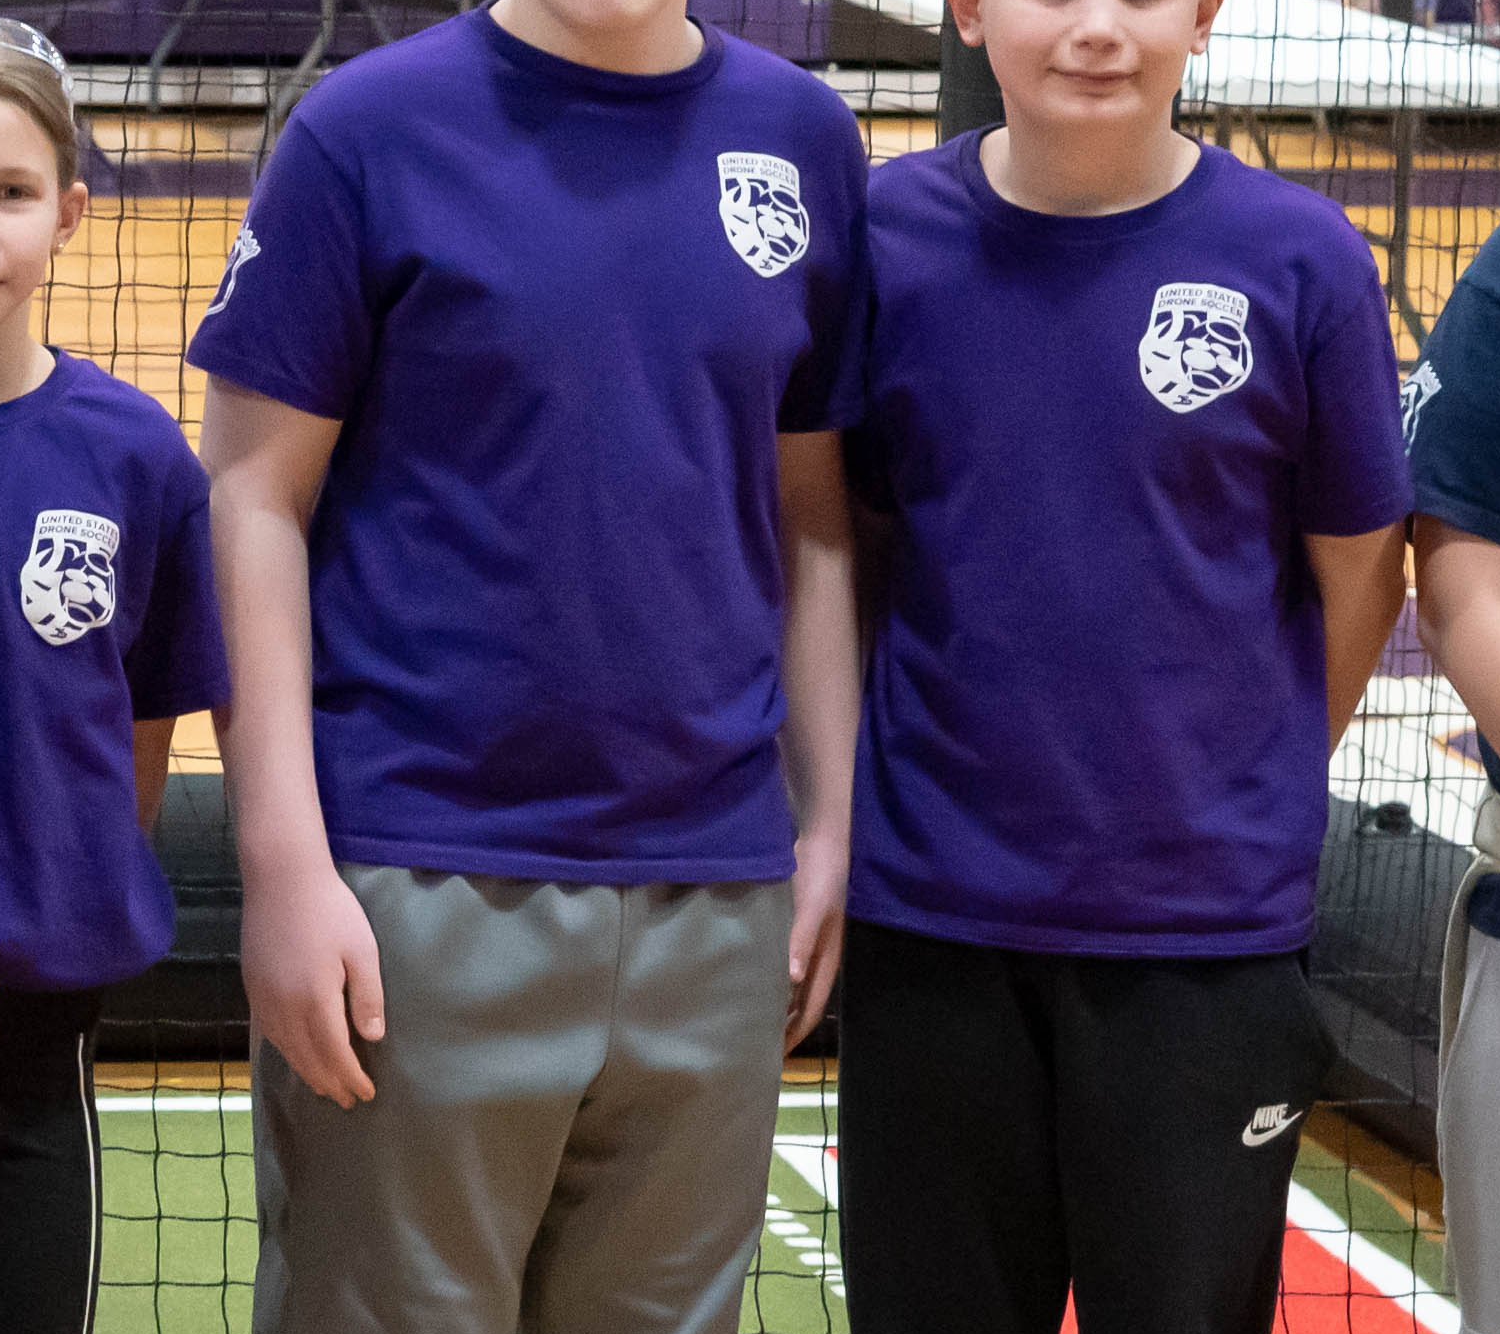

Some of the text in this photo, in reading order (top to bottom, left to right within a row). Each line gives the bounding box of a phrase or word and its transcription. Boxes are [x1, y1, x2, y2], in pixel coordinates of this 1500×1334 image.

[1158, 297, 1243, 318] DRONE SOCCER
[1160, 288, 1245, 309] UNITED STATES
[1252, 1103, 1289, 1130] NIKE
